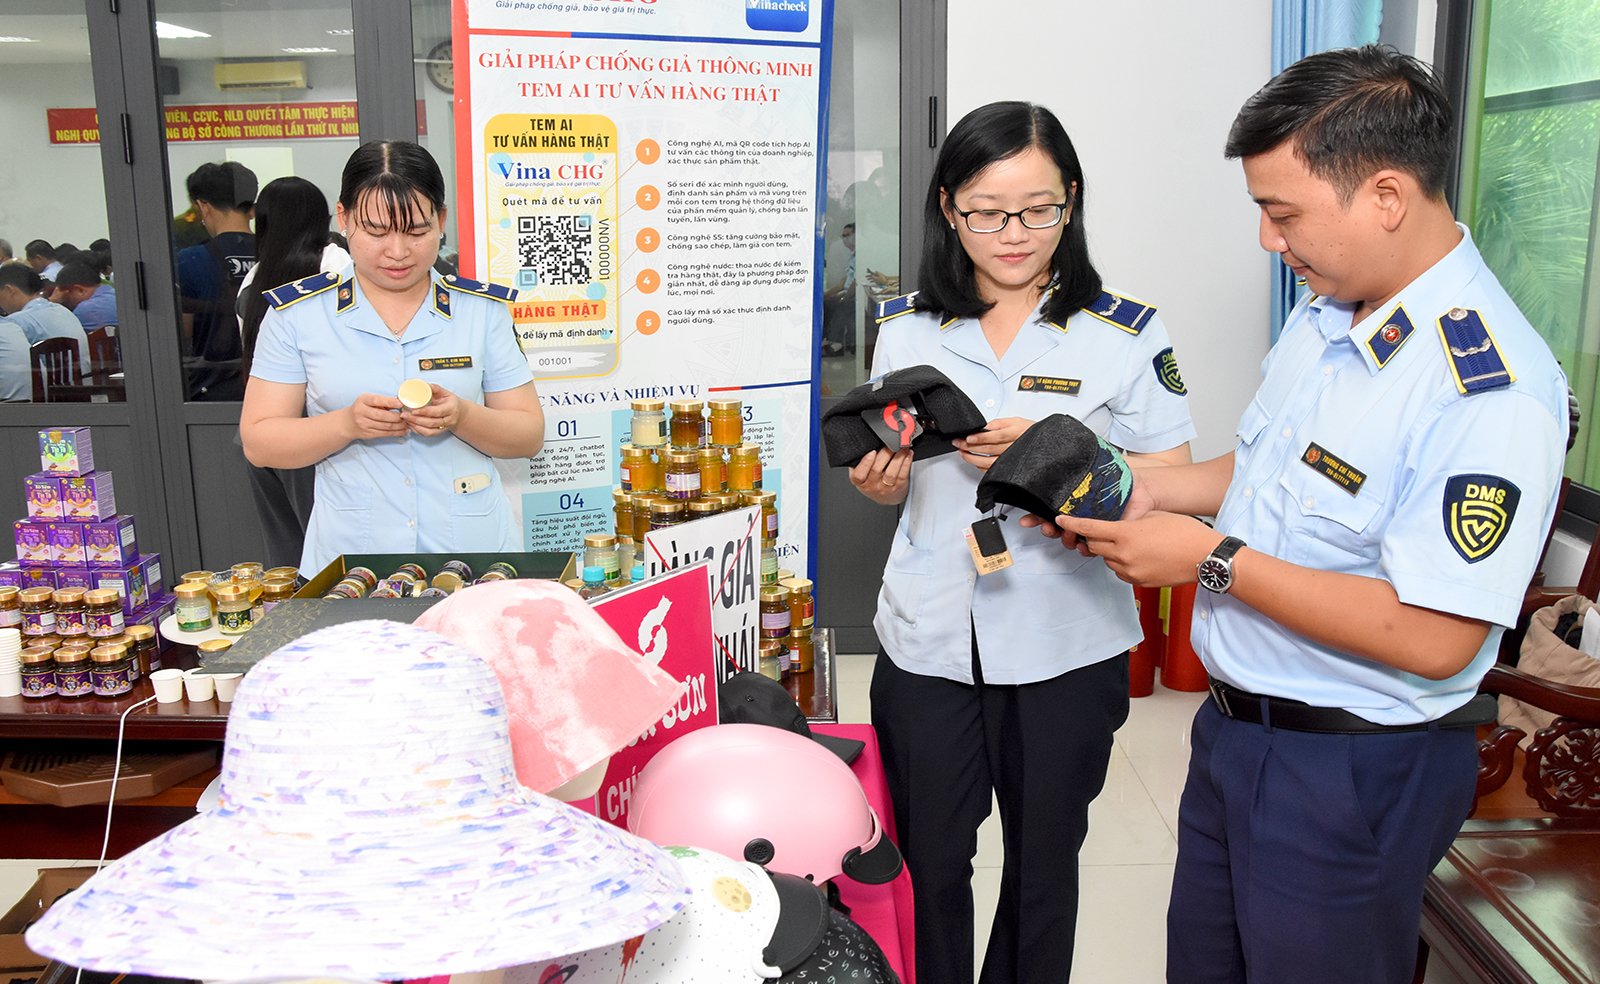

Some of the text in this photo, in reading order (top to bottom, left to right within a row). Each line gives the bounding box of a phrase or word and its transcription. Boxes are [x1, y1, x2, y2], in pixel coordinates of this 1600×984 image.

[496, 0, 513, 8] Giải
[514, 2, 535, 10] pháp
[537, 2, 563, 12] chống
[565, 4, 580, 12] giả,
[583, 4, 598, 12] bảo
[612, 6, 625, 14] giá
[478, 49, 812, 77] GIẢI PHÁP CHỐNG GIẢ THÔNG MINH
[517, 79, 781, 105] TEM AI TƯ VẤN HÀNG THẬT
[165, 110, 191, 123] VIÊN,
[193, 110, 222, 124] CCVC,
[246, 107, 276, 121] QUYẾT
[279, 106, 301, 120] TÂM
[303, 107, 328, 122] THỰC
[332, 105, 354, 121] HIỆN
[166, 121, 359, 141] NG BỘ SỞ CÔNG THƯƠNG LẦN THỨ IV, NHI
[530, 118, 572, 130] TEM AI
[56, 129, 100, 142] NGHỊ QUY
[492, 132, 610, 150] TƯ VẤN HÀNG THẬT
[645, 147, 650, 156] 1
[498, 162, 602, 180] Vina CHG
[502, 194, 602, 207] Quét mã để tư vấn
[645, 193, 652, 202] 2
[644, 236, 651, 244] 3
[599, 218, 610, 280] VN000001
[643, 277, 651, 285] 4
[512, 302, 599, 318] HÀNG THẬT
[646, 319, 652, 327] 5
[522, 328, 608, 340] để lấy mã định danh
[538, 357, 572, 366] 001001
[1162, 352, 1176, 363] DM
[550, 392, 595, 406] NĂNG
[600, 387, 620, 402] VÀ
[624, 385, 674, 401] NHIỆM
[678, 384, 700, 398] VỤ
[743, 406, 753, 421] 3
[558, 420, 577, 437] 01
[560, 493, 584, 510] 04
[1465, 484, 1506, 504] DMS
[721, 513, 755, 609] GIẢ
